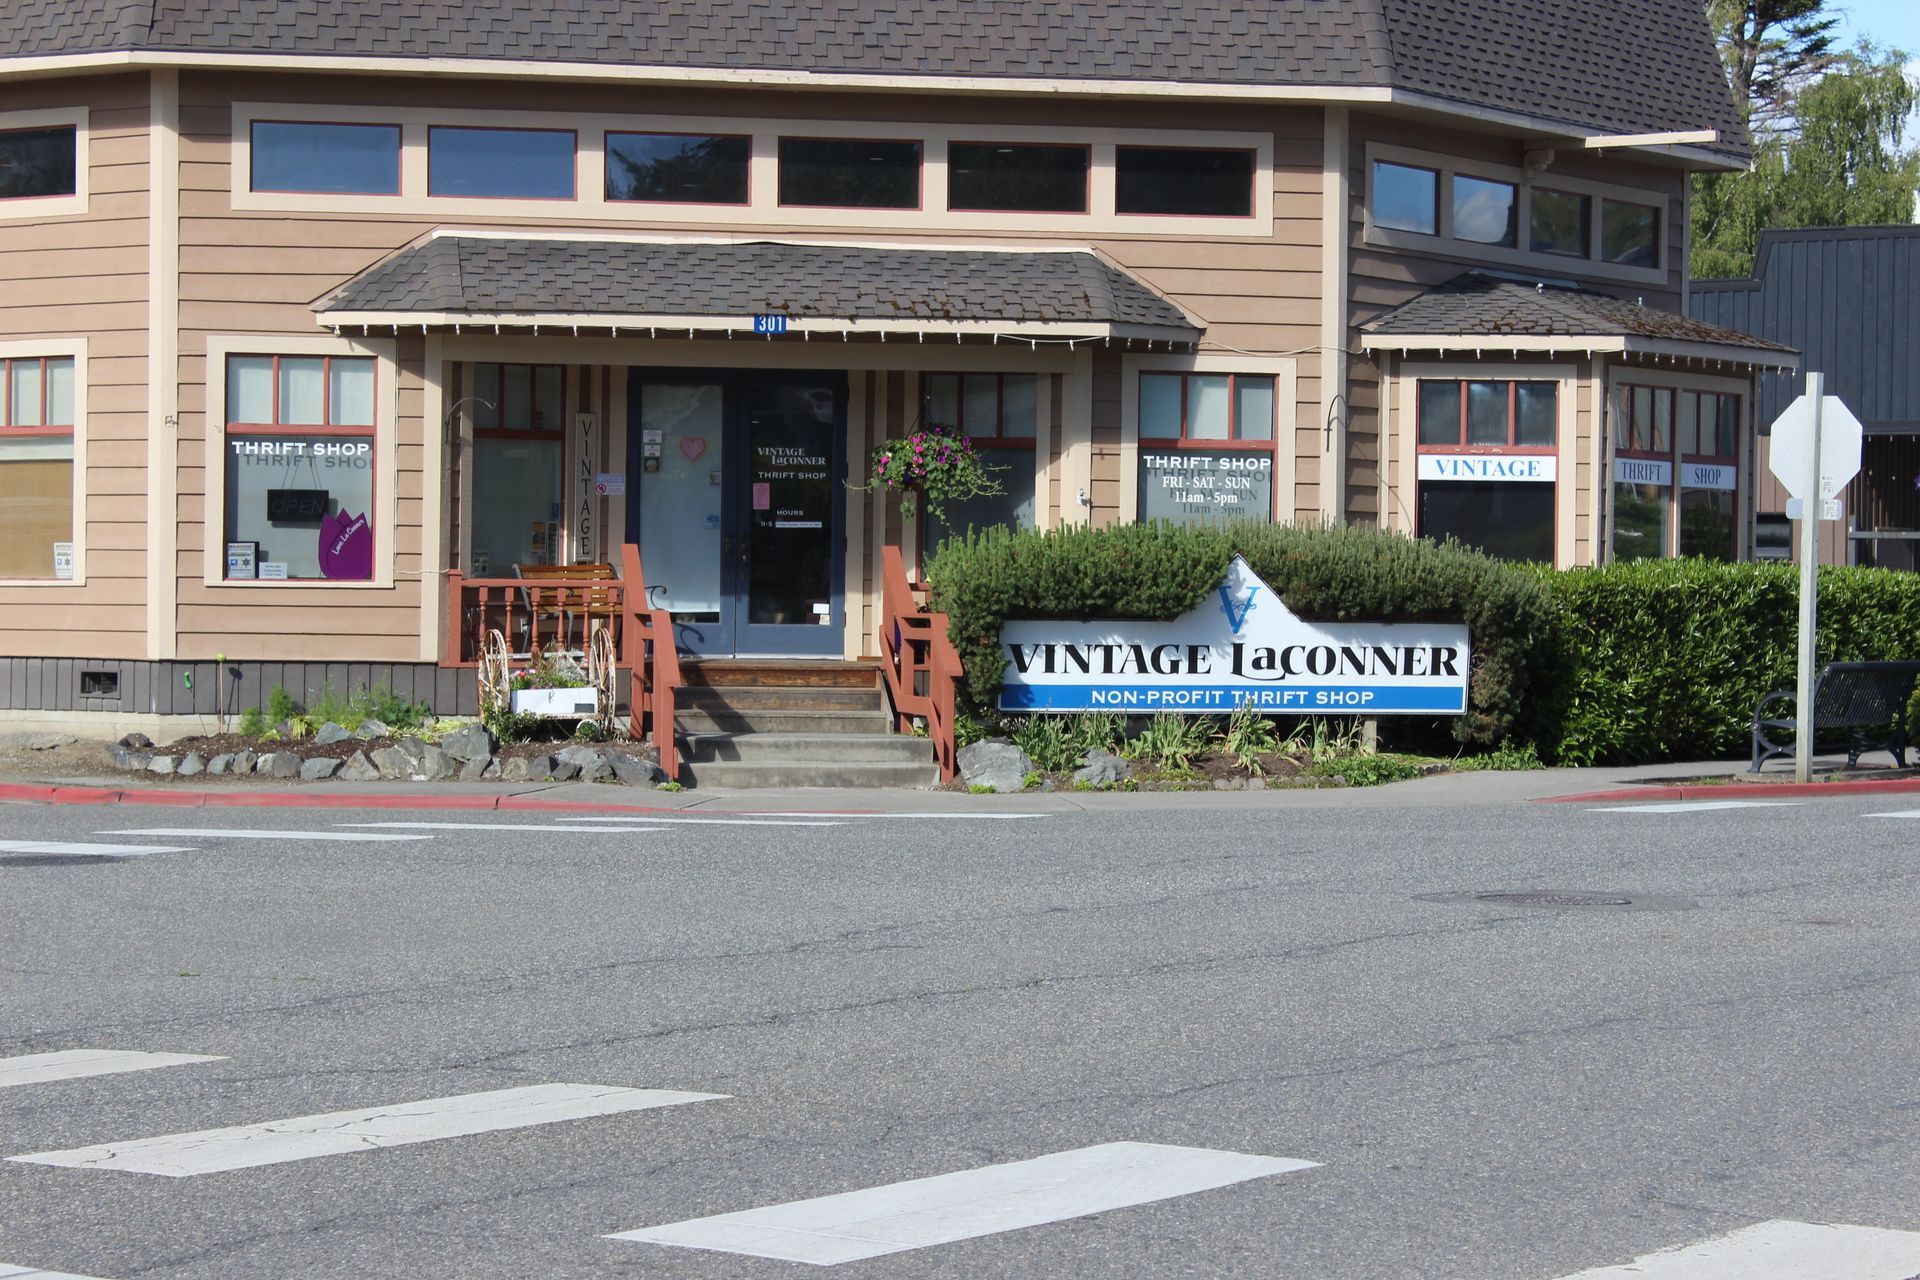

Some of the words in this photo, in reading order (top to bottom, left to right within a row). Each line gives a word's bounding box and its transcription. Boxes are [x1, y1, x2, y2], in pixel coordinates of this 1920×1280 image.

[759, 315, 782, 331] 301
[231, 441, 306, 455] THRIFT
[313, 443, 370, 455] SHOP
[757, 447, 805, 456] VINTAGE
[771, 455, 826, 466] LaCONNER
[1143, 455, 1212, 469] THRIFT
[1219, 457, 1271, 470] SHOP
[1435, 459, 1541, 477] VINTAGE
[1621, 461, 1662, 481] THRIFT
[1694, 467, 1721, 485] SHOP
[580, 420, 592, 555] VINTAGE
[1162, 476, 1184, 488] FRI
[1192, 476, 1216, 489] SAT
[1224, 476, 1251, 489] SUN
[272, 498, 325, 514] OPEN
[1175, 491, 1204, 503] 11am
[1214, 491, 1238, 506] 5pm
[1007, 643, 1212, 675] VINTAGE
[1230, 642, 1460, 681] LaCONNER
[1091, 690, 1224, 704] NON-PROFIT
[1231, 690, 1308, 704] THRIFT
[1316, 691, 1375, 705] SHOP
